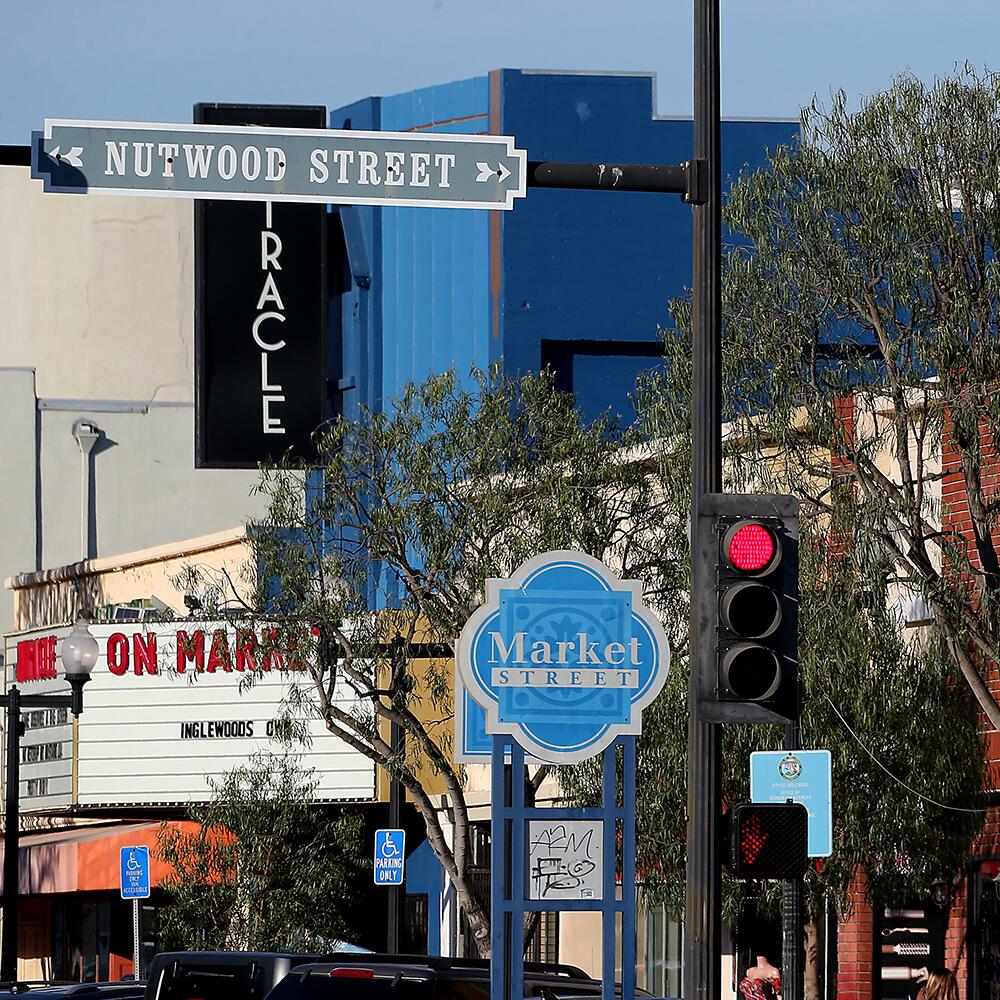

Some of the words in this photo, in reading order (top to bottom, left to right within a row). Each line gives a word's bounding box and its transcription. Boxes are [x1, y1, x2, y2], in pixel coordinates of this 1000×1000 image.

[104, 140, 286, 182] NUTWOOD
[309, 148, 456, 188] STREET
[252, 201, 287, 434] IRACLE
[107, 632, 159, 676] ON
[487, 631, 644, 666] Market
[499, 670, 632, 686] STREET
[181, 720, 254, 739] INGLEWOODS
[376, 857, 402, 868] PARKING
[380, 869, 398, 881] ONLY
